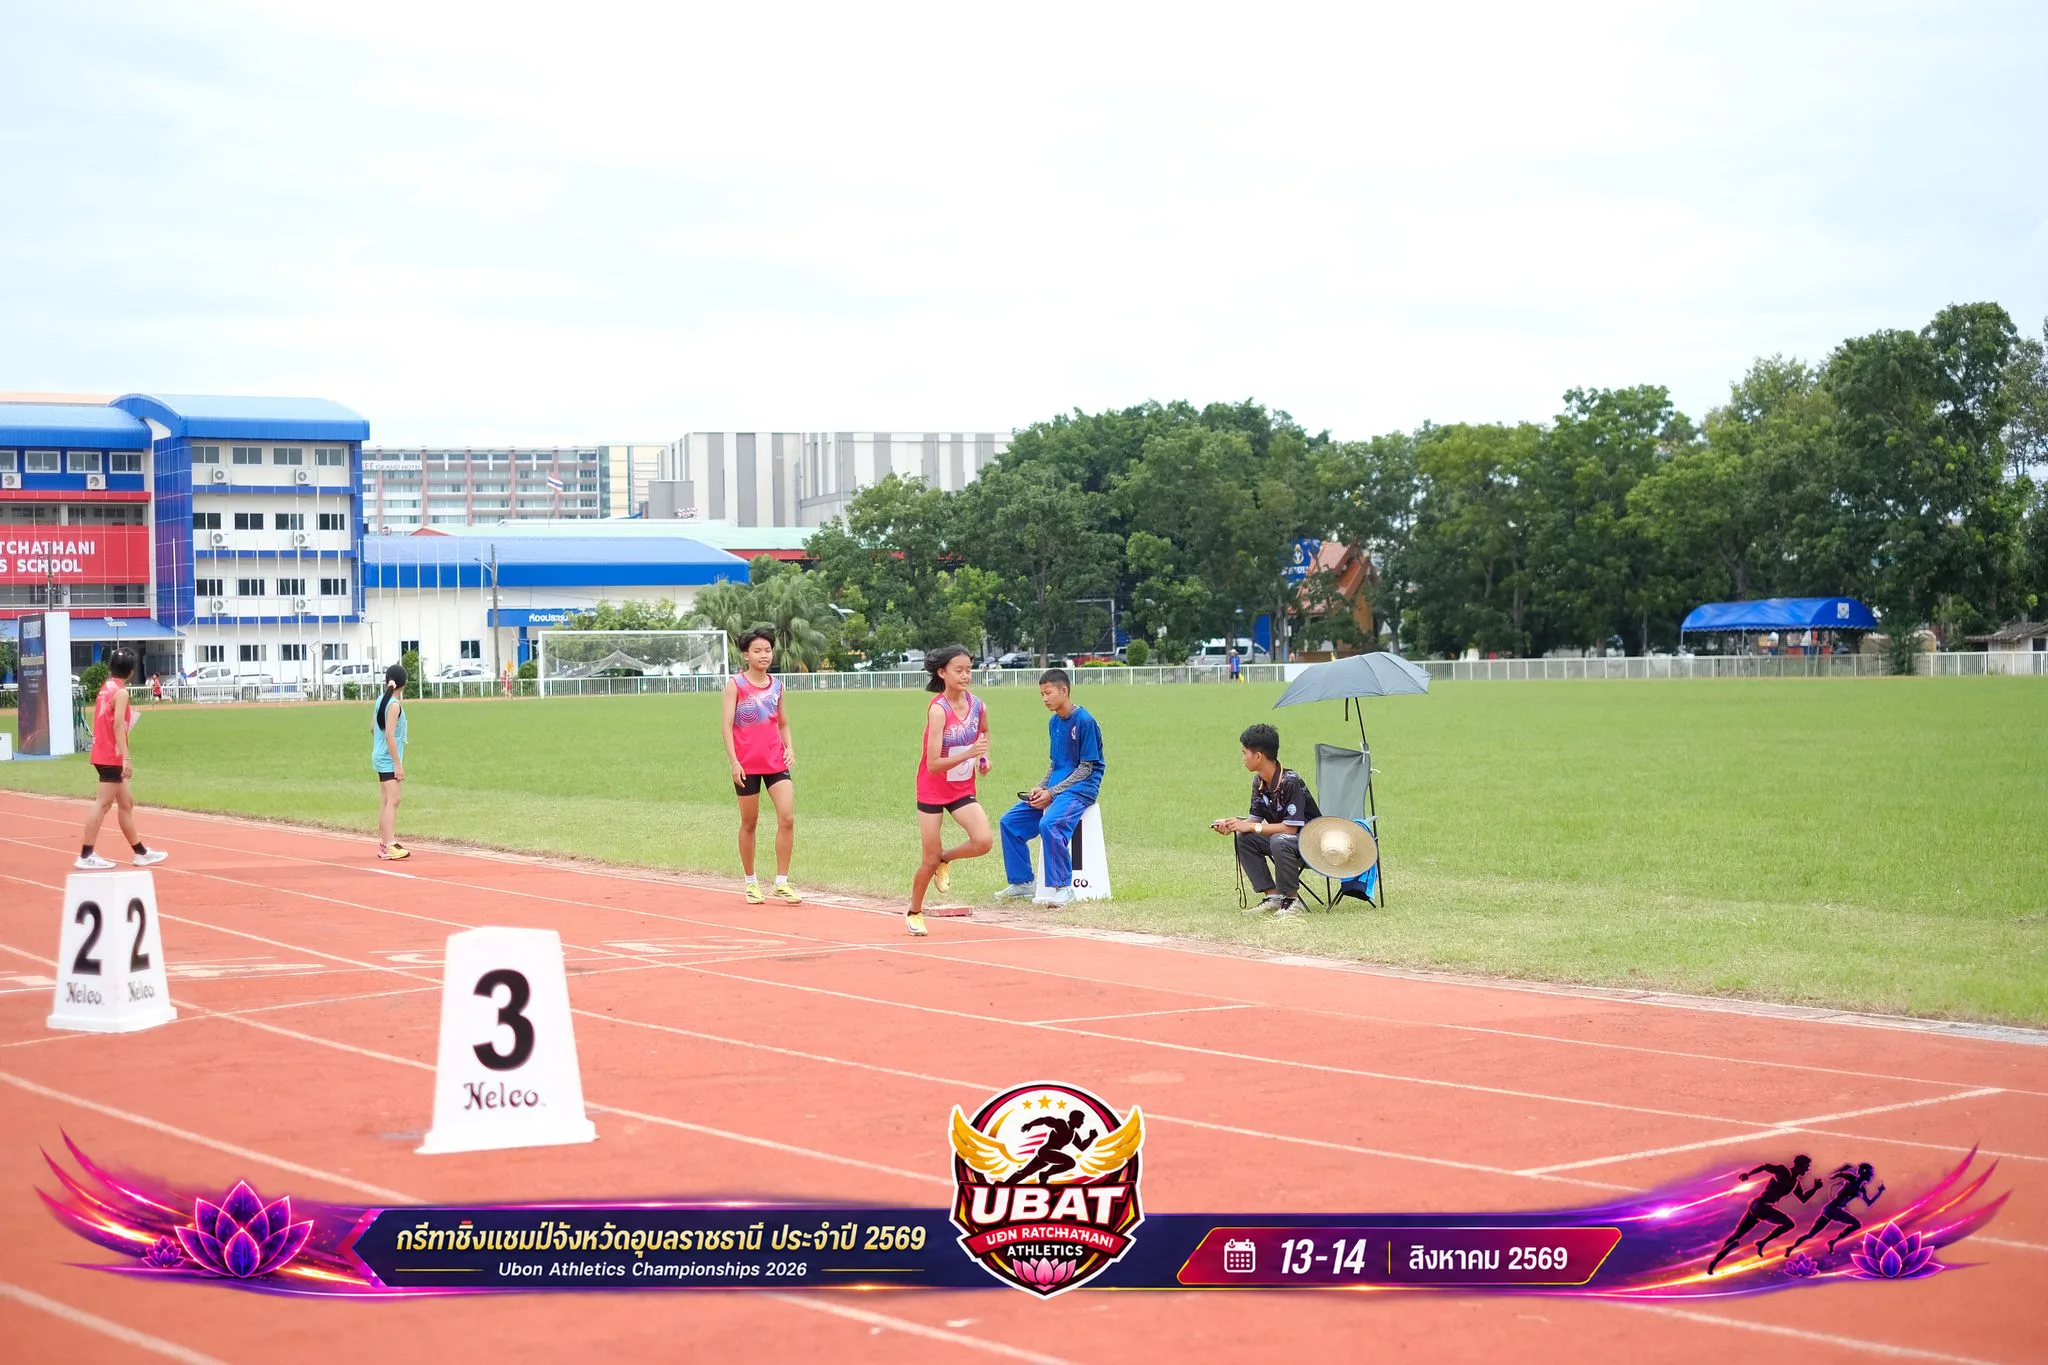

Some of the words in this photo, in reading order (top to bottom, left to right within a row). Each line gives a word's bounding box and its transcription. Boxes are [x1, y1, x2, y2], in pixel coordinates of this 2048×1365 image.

[16, 558, 83, 573] SCHOOL
[72, 900, 103, 976] 2
[127, 897, 151, 973] 2
[473, 968, 535, 1071] 3
